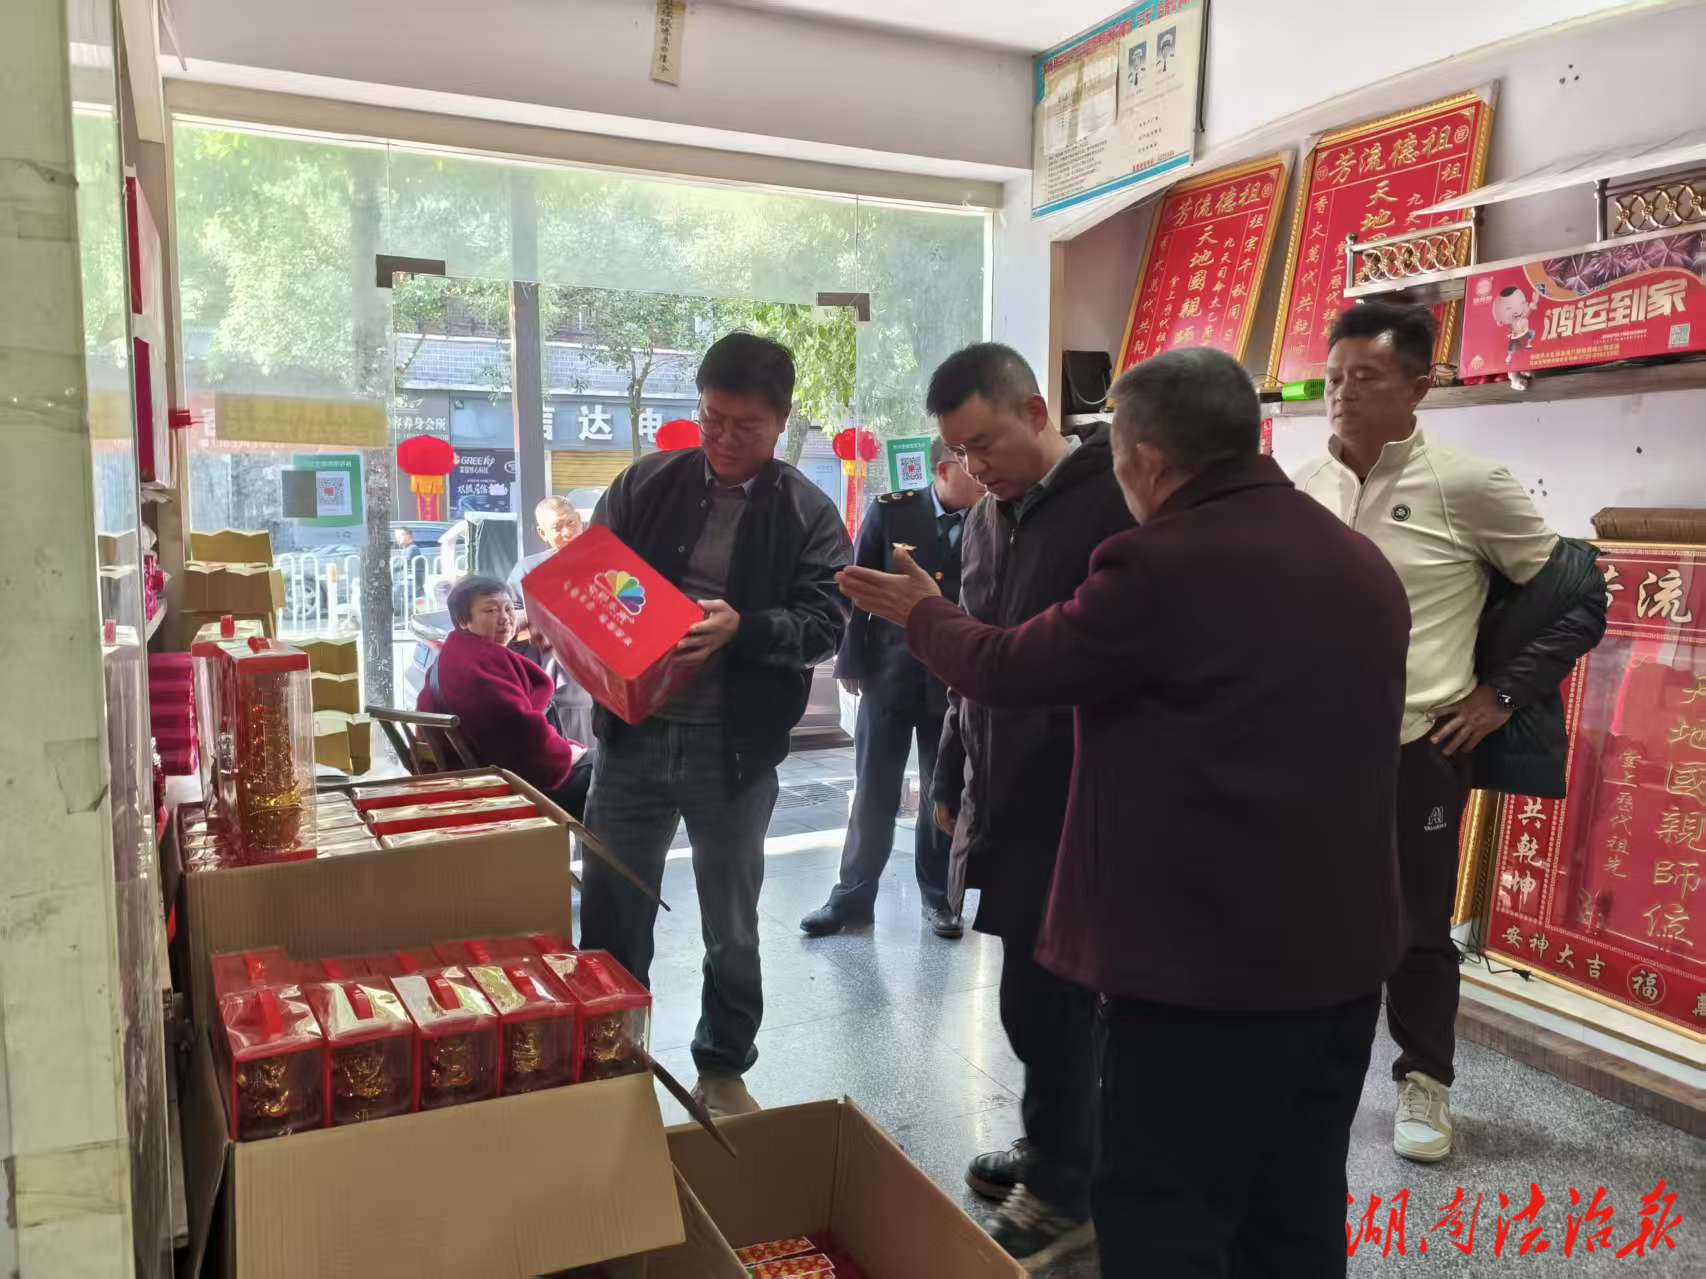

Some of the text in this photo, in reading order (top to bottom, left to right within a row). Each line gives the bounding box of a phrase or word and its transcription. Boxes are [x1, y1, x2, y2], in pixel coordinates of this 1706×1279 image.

[1541, 278, 1688, 342] 鸿运到家
[1502, 924, 1607, 979] 安神大吉
[1631, 969, 1659, 1001] 福
